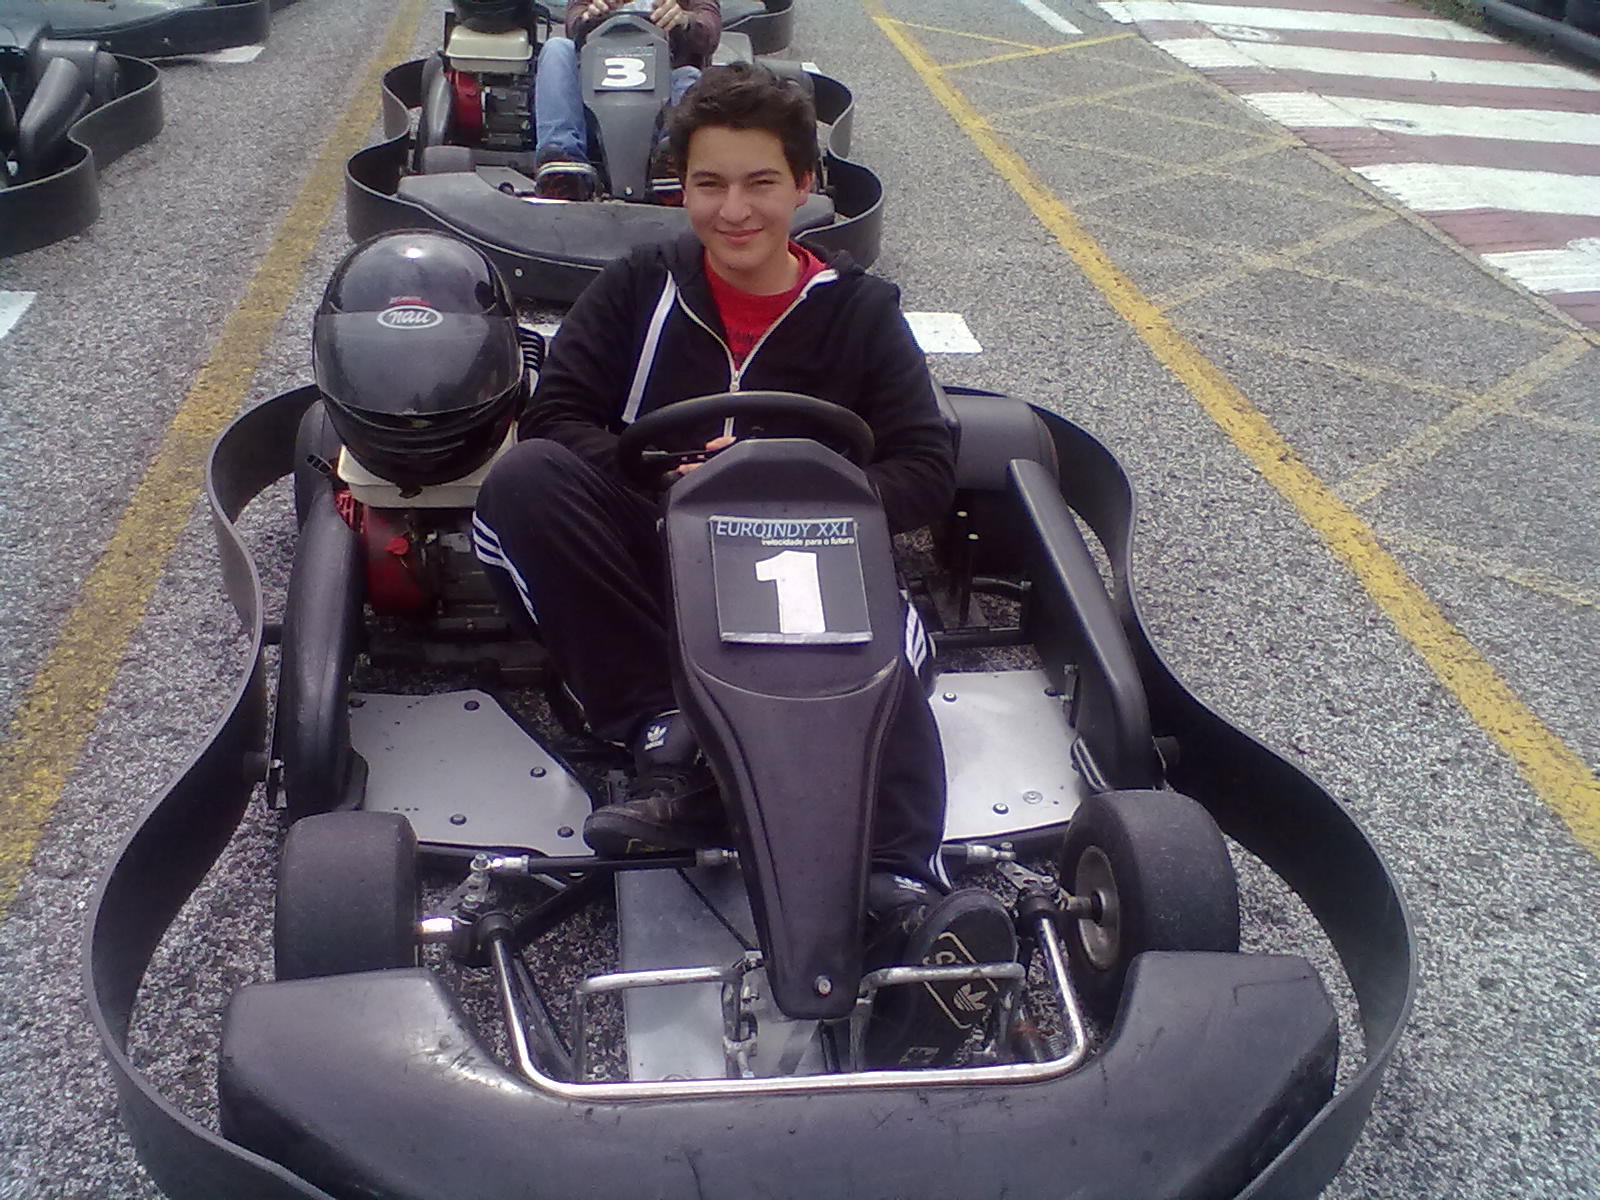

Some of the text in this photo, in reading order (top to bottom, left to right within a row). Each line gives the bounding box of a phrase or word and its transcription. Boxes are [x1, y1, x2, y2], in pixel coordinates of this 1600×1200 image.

[601, 57, 647, 87] 3
[716, 521, 848, 537] EUROINDY XXI
[761, 537, 803, 546] velocidade
[804, 538, 823, 547] para
[830, 537, 855, 545] futuro
[755, 550, 826, 633] 1
